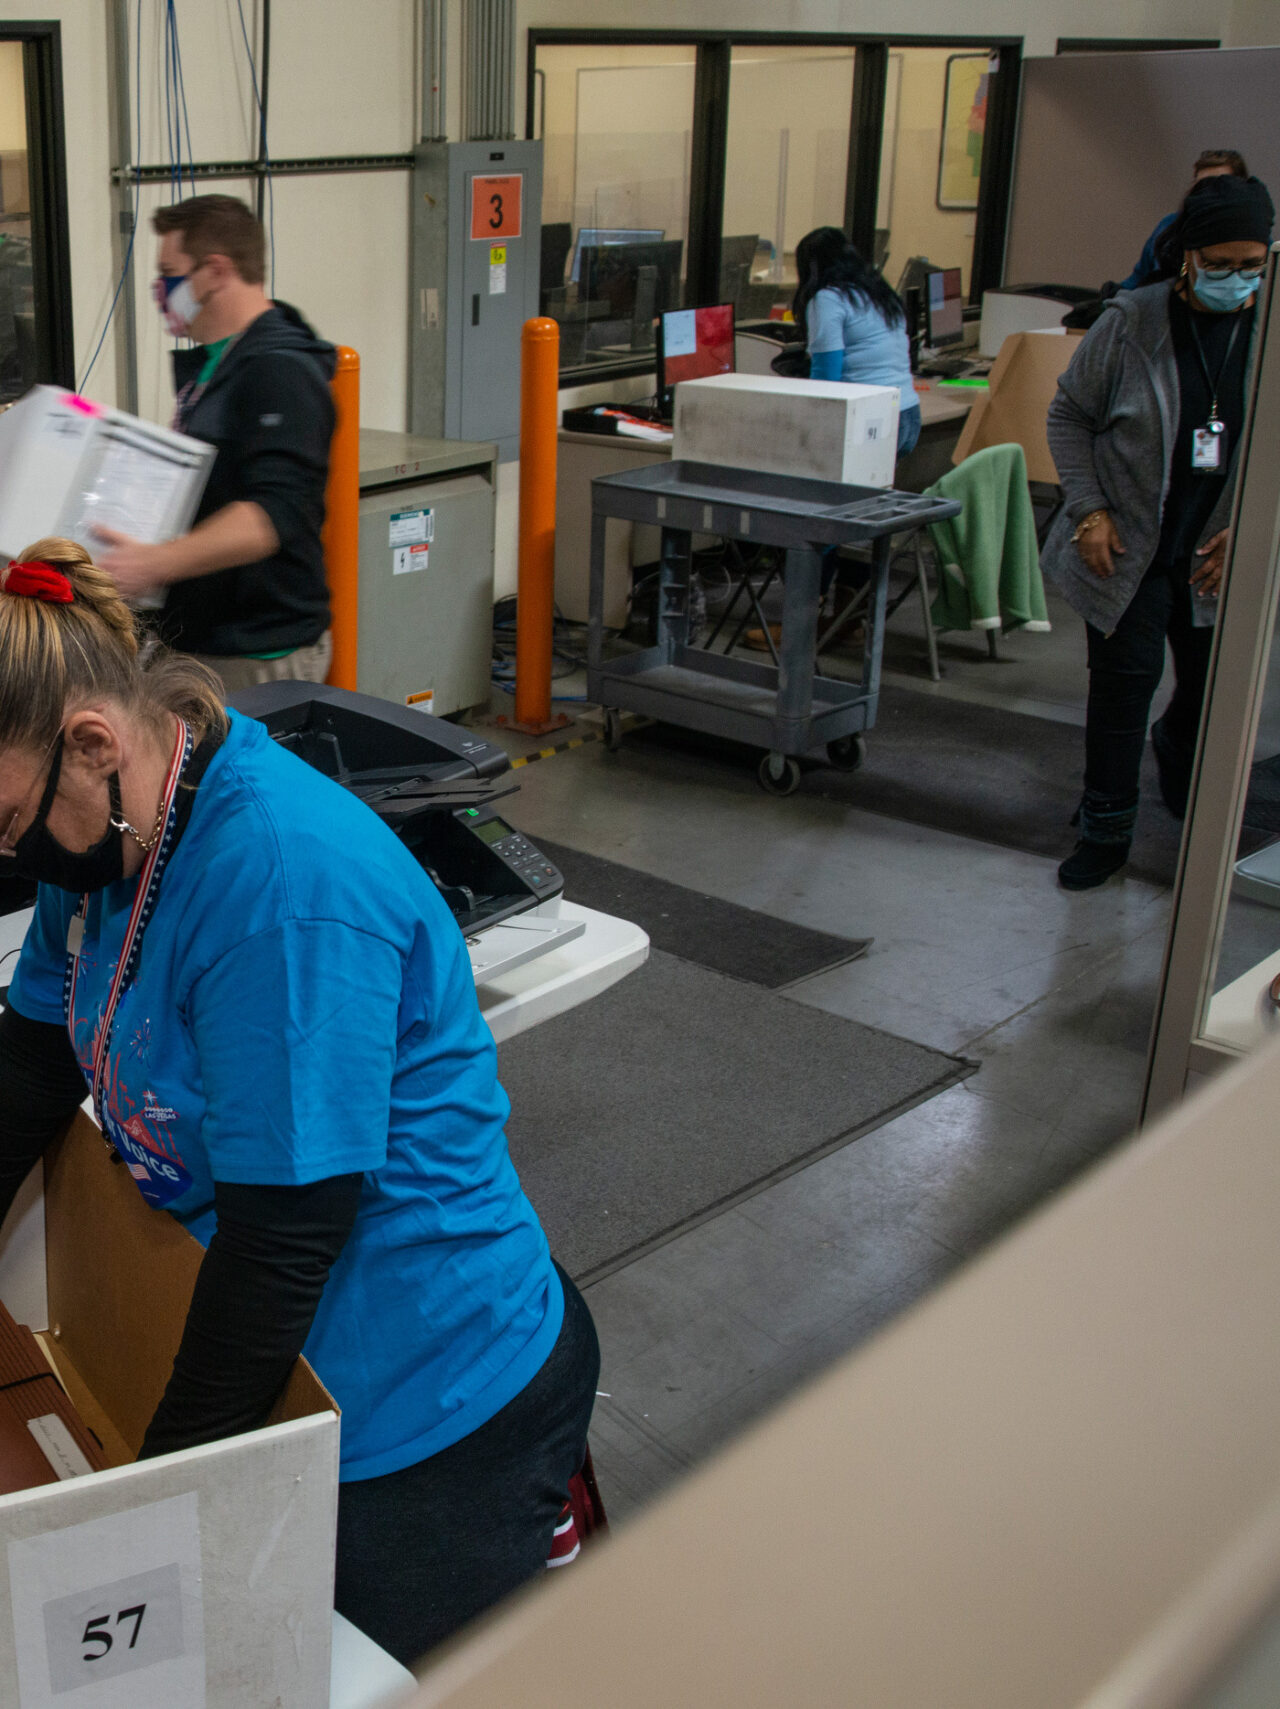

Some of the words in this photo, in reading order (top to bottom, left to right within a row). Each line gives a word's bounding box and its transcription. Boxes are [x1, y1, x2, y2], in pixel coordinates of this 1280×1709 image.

[489, 194, 503, 228] 3
[867, 427, 877, 440] 91
[117, 1125, 180, 1181] Voice
[82, 1603, 147, 1662] 57
